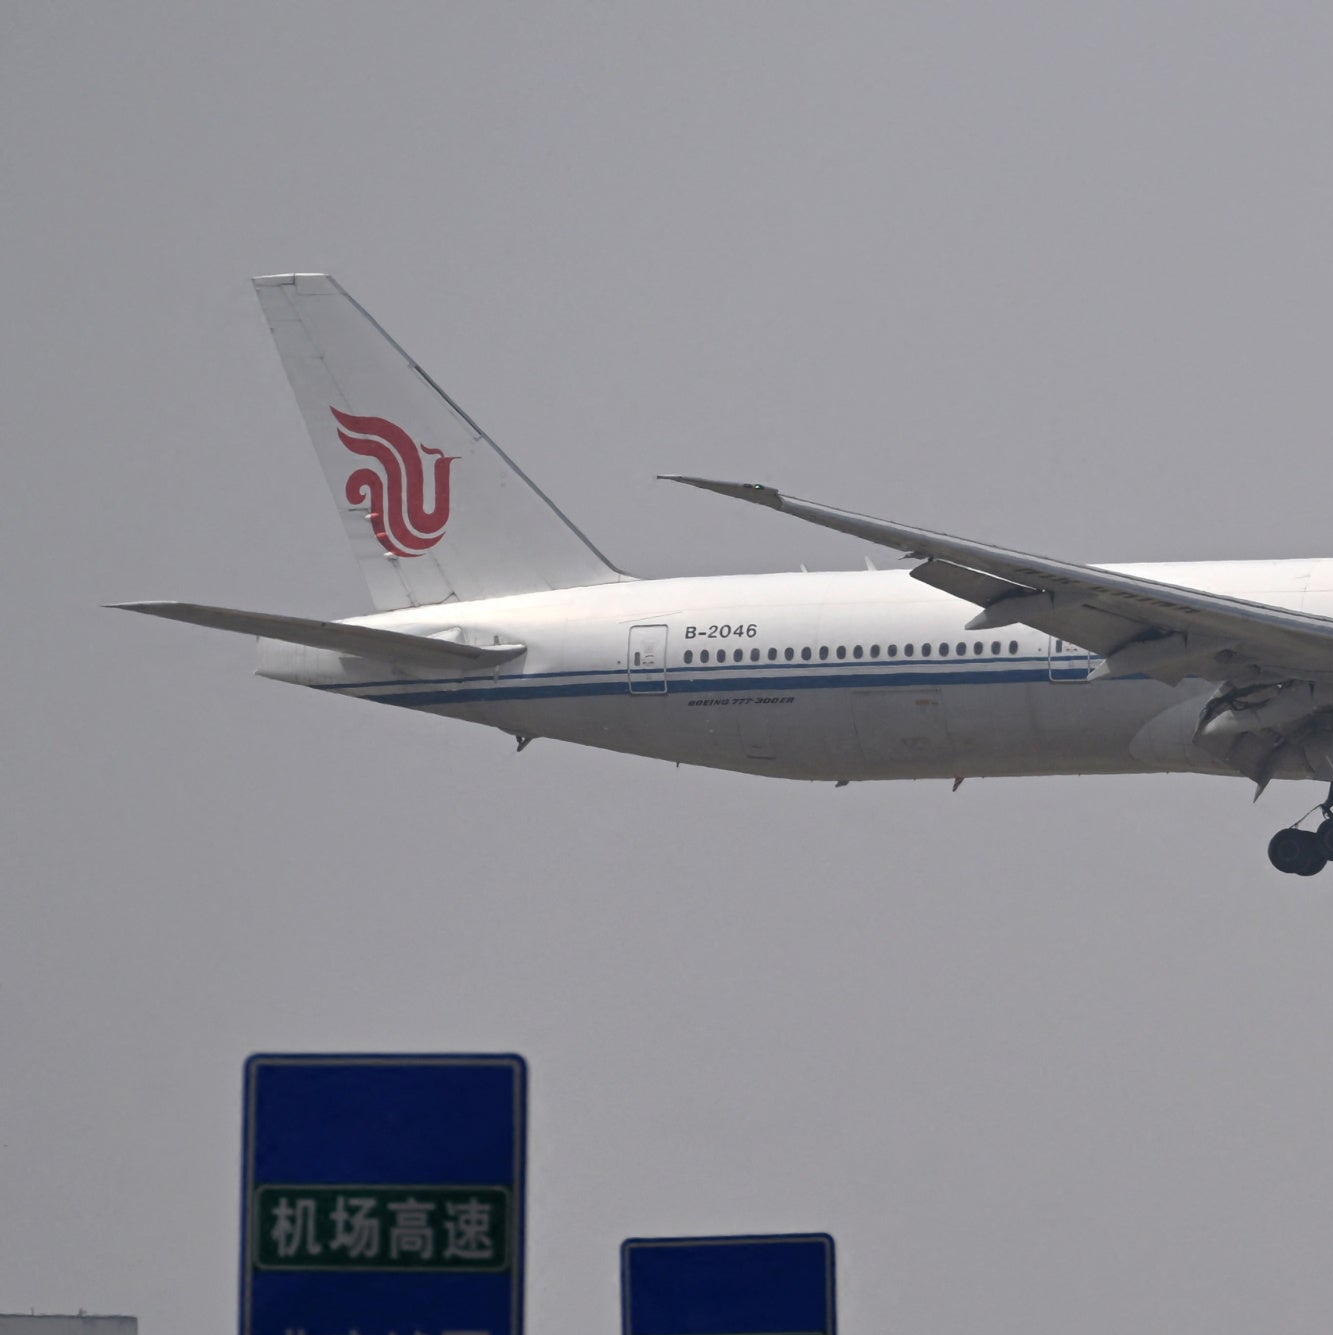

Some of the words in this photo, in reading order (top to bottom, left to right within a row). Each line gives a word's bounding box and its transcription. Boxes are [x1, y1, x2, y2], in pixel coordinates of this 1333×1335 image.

[685, 624, 758, 640] B-2046
[687, 699, 729, 707] BOEING
[731, 696, 795, 705] 777-300ER
[270, 1195, 493, 1260] 机场高速
